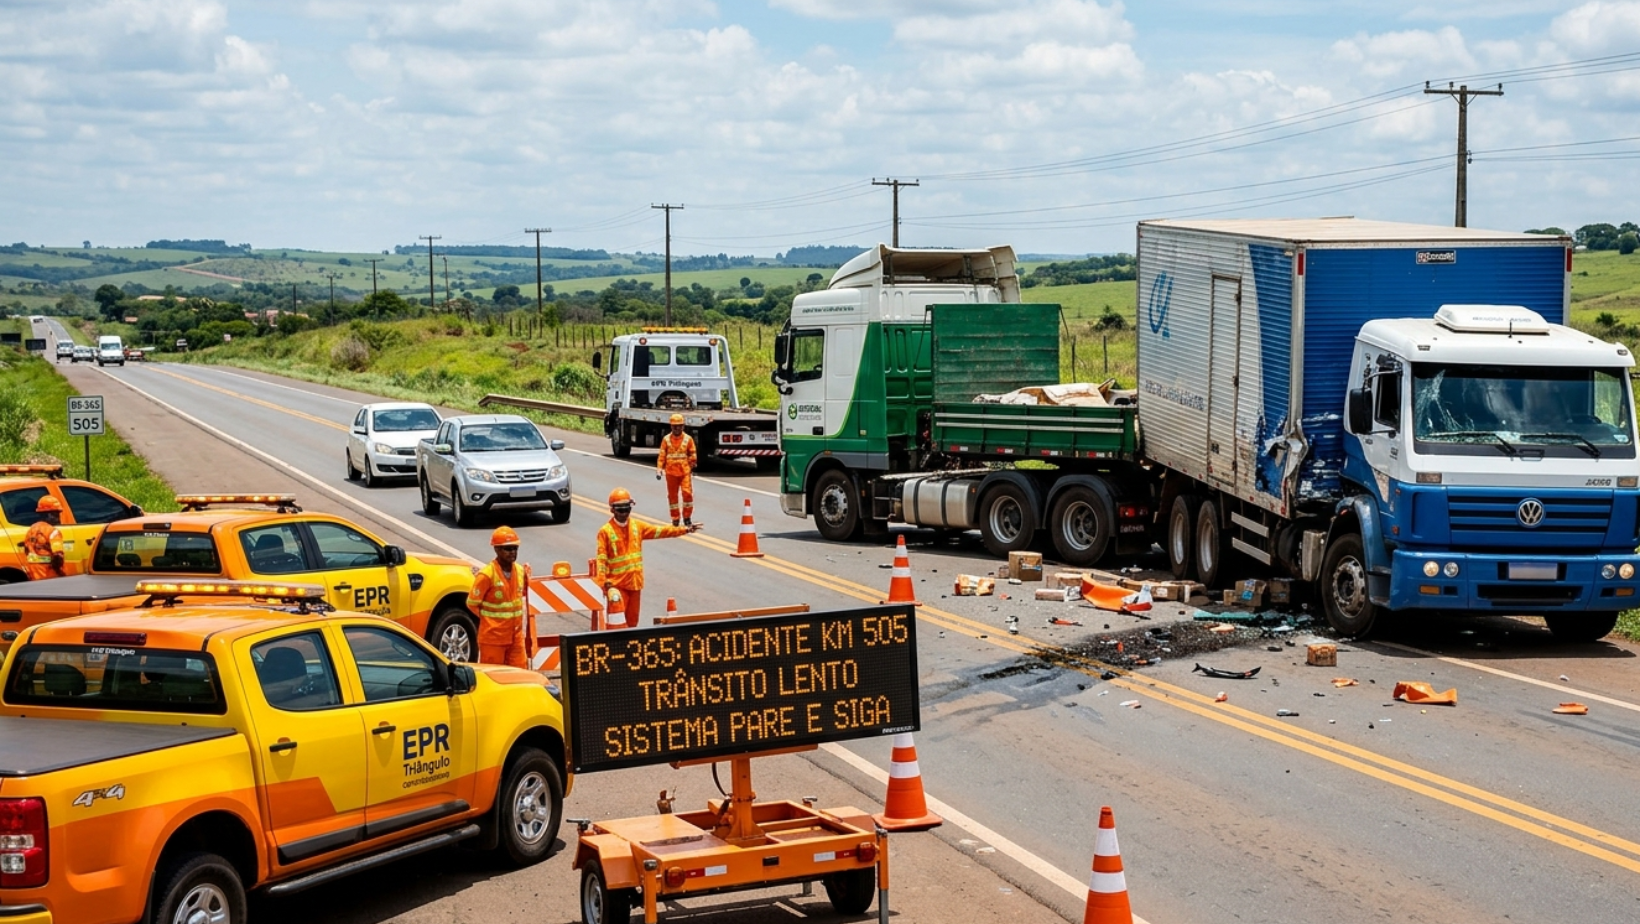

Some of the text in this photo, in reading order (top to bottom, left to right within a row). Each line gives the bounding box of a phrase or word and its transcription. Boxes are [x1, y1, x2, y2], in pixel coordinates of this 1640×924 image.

[73, 417, 99, 430] 505
[354, 585, 391, 608] EPR
[575, 614, 909, 676] BR-365: ACIDENTE KM 505
[638, 659, 859, 711] TRÂNSITO LENTO
[402, 723, 450, 760] EPR
[604, 695, 891, 758] SISTEMA PARE E SIGA
